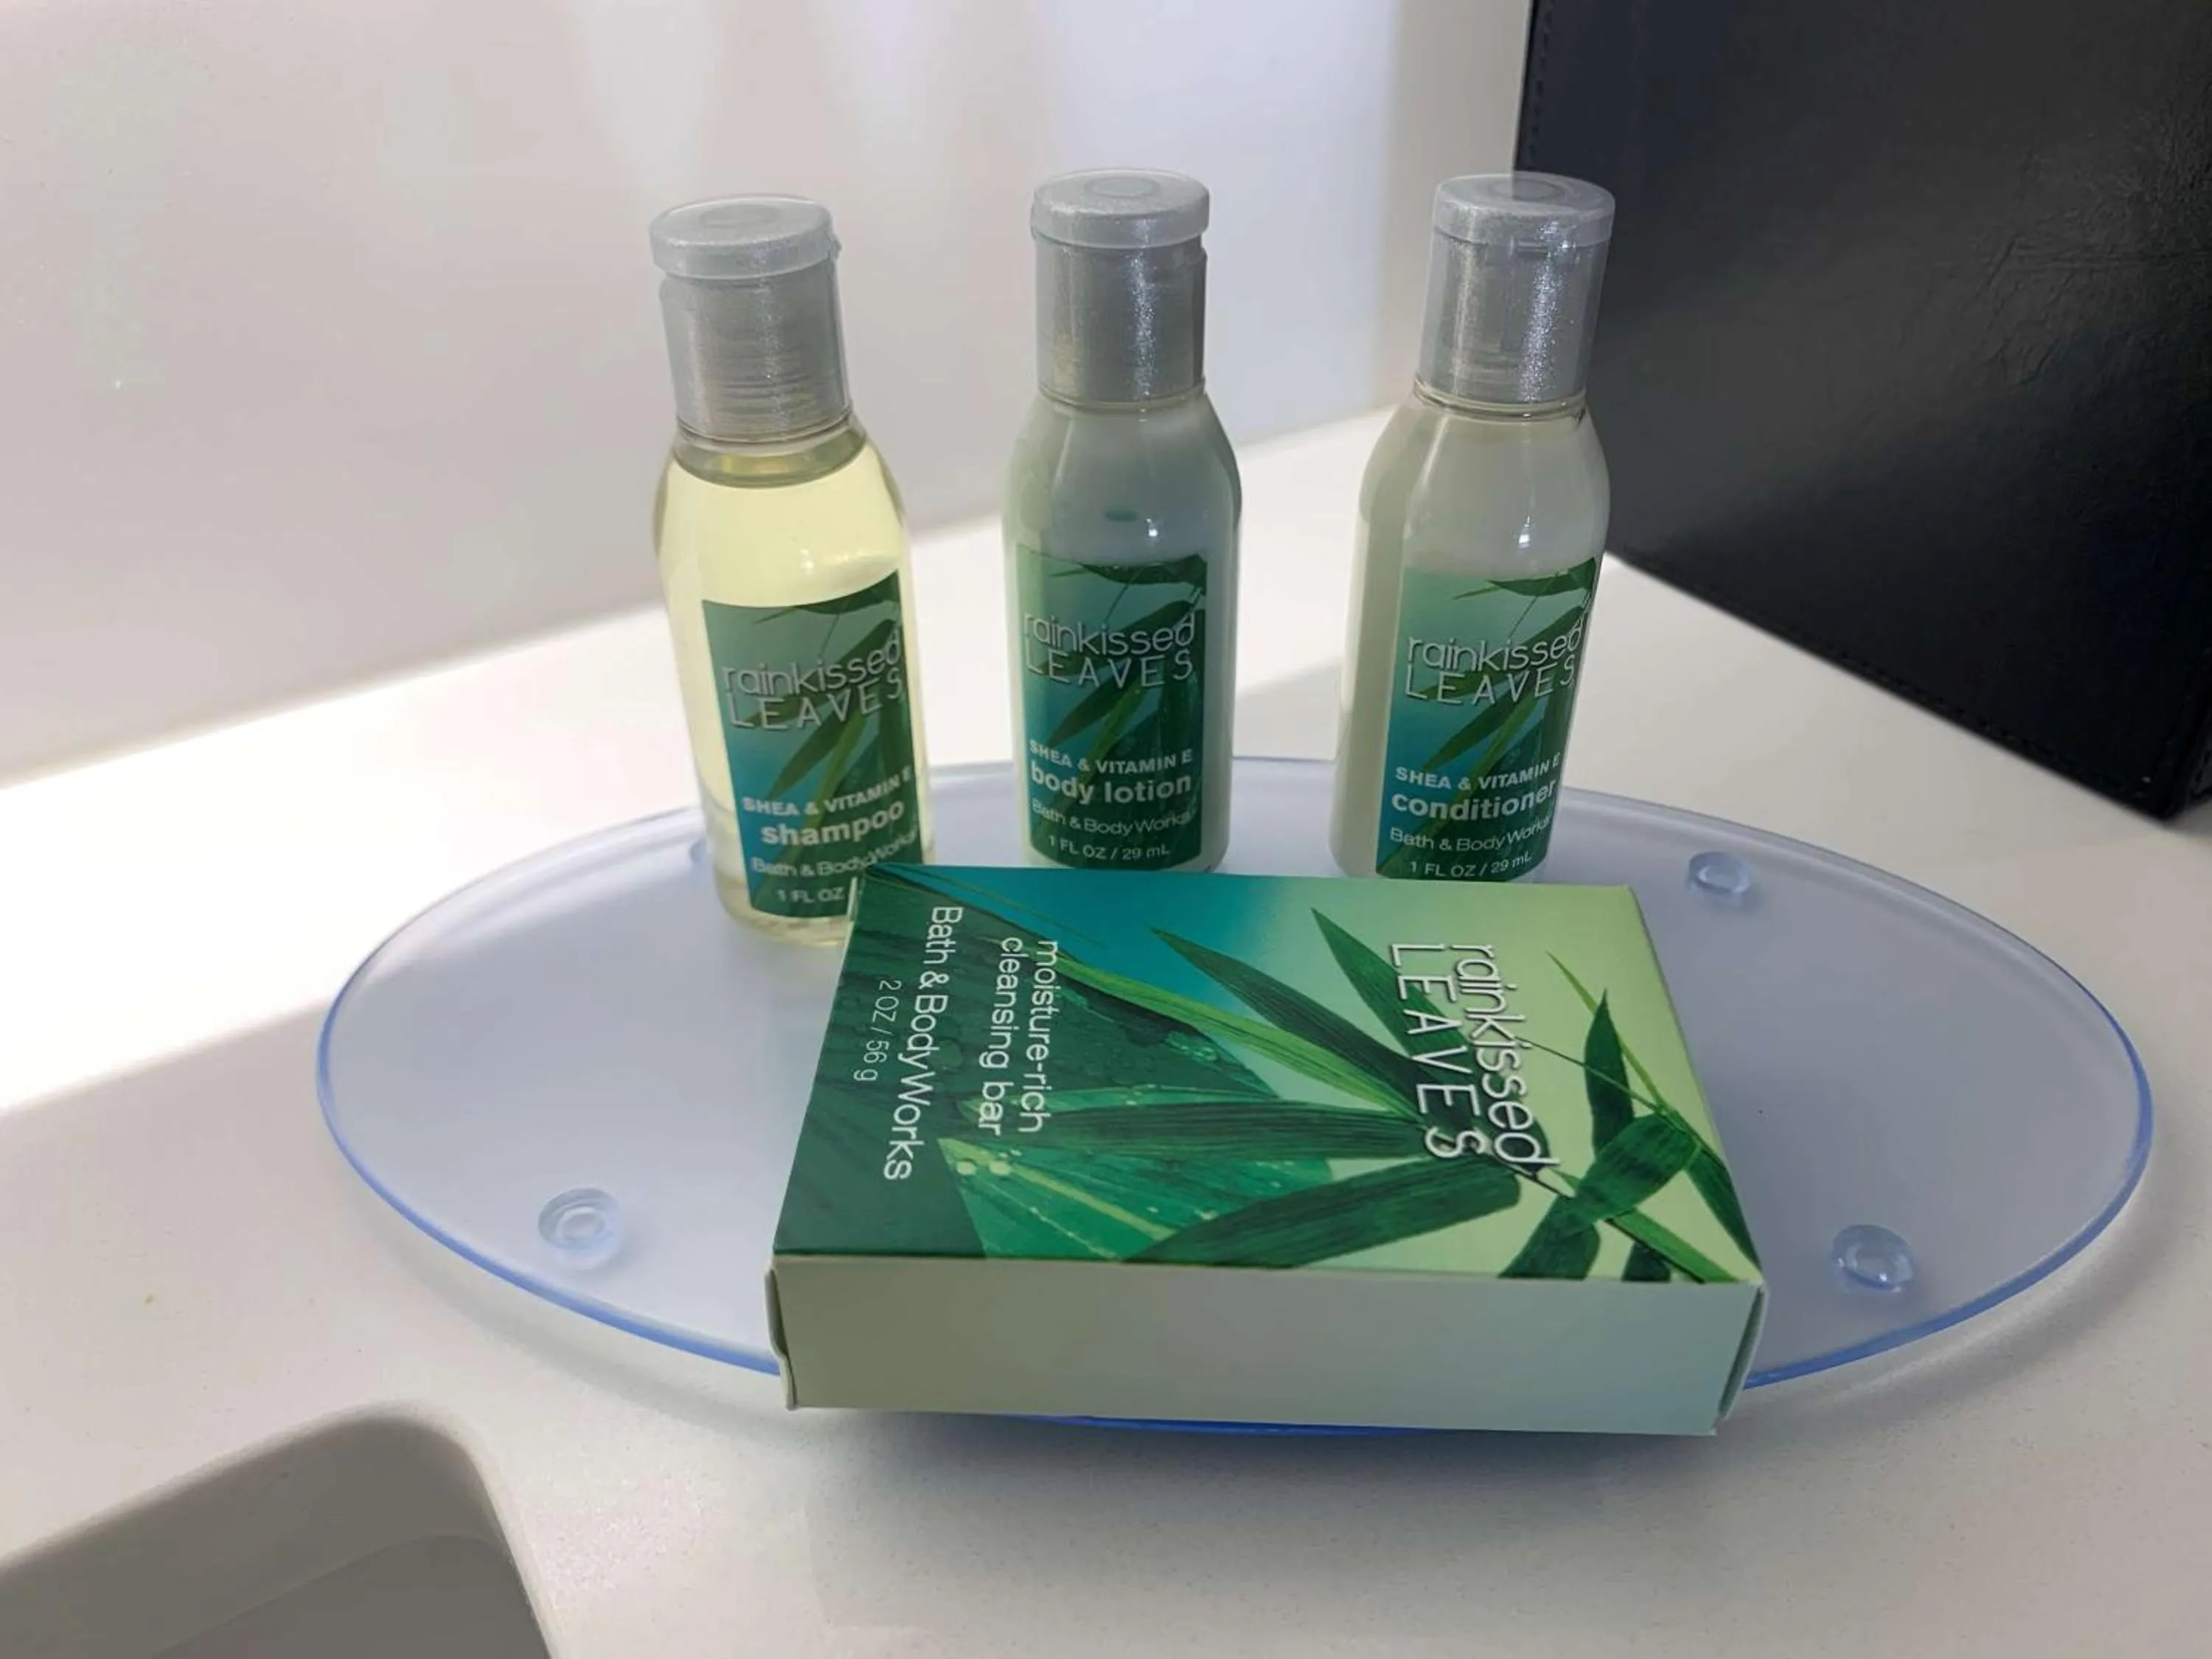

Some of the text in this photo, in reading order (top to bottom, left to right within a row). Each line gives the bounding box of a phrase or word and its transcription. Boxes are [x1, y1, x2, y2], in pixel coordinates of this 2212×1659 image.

[1024, 611, 1196, 657] rainkissed
[1407, 615, 1584, 672] rainkissed
[722, 629, 901, 695] rainkissed
[1025, 636, 1194, 689] LEAVES
[1405, 653, 1575, 706] LEAVES
[726, 667, 902, 729] LEAVES
[1029, 740, 1193, 775] SHEA & VITAMIN E
[1395, 752, 1561, 791] SHEA & VITAMIN E
[742, 797, 800, 816] SHEA
[804, 801, 819, 815] &
[824, 775, 901, 813] VITAMIN
[1031, 760, 1192, 804] body lotion
[1391, 779, 1557, 821] conditioner
[760, 801, 905, 846] shampoo
[1032, 797, 1066, 826] Bath
[1069, 816, 1082, 830] &
[1048, 835, 1055, 846] 1
[1060, 838, 1080, 855] FL
[1082, 844, 1107, 860] OZ
[1121, 847, 1142, 860] 29
[1146, 844, 1171, 858] mL
[1390, 827, 1435, 850] Bath
[1439, 839, 1453, 851] &
[751, 857, 798, 877] Bath
[801, 864, 816, 877] &
[1410, 861, 1417, 872] 1
[1425, 863, 1447, 877] FL
[1450, 864, 1476, 877] OZ
[1490, 858, 1509, 874] 29
[1512, 850, 1533, 868] mL
[778, 886, 846, 903] 1 FL OZ
[922, 906, 964, 965] Bath
[919, 970, 950, 990] &
[853, 978, 902, 1082] 2 OZ / 56 g
[978, 936, 1029, 1137] cleansing bar
[1017, 939, 1061, 1133] moisture-rich
[1391, 943, 1489, 1159] LEAVES
[1449, 943, 1562, 1165] rainkissed
